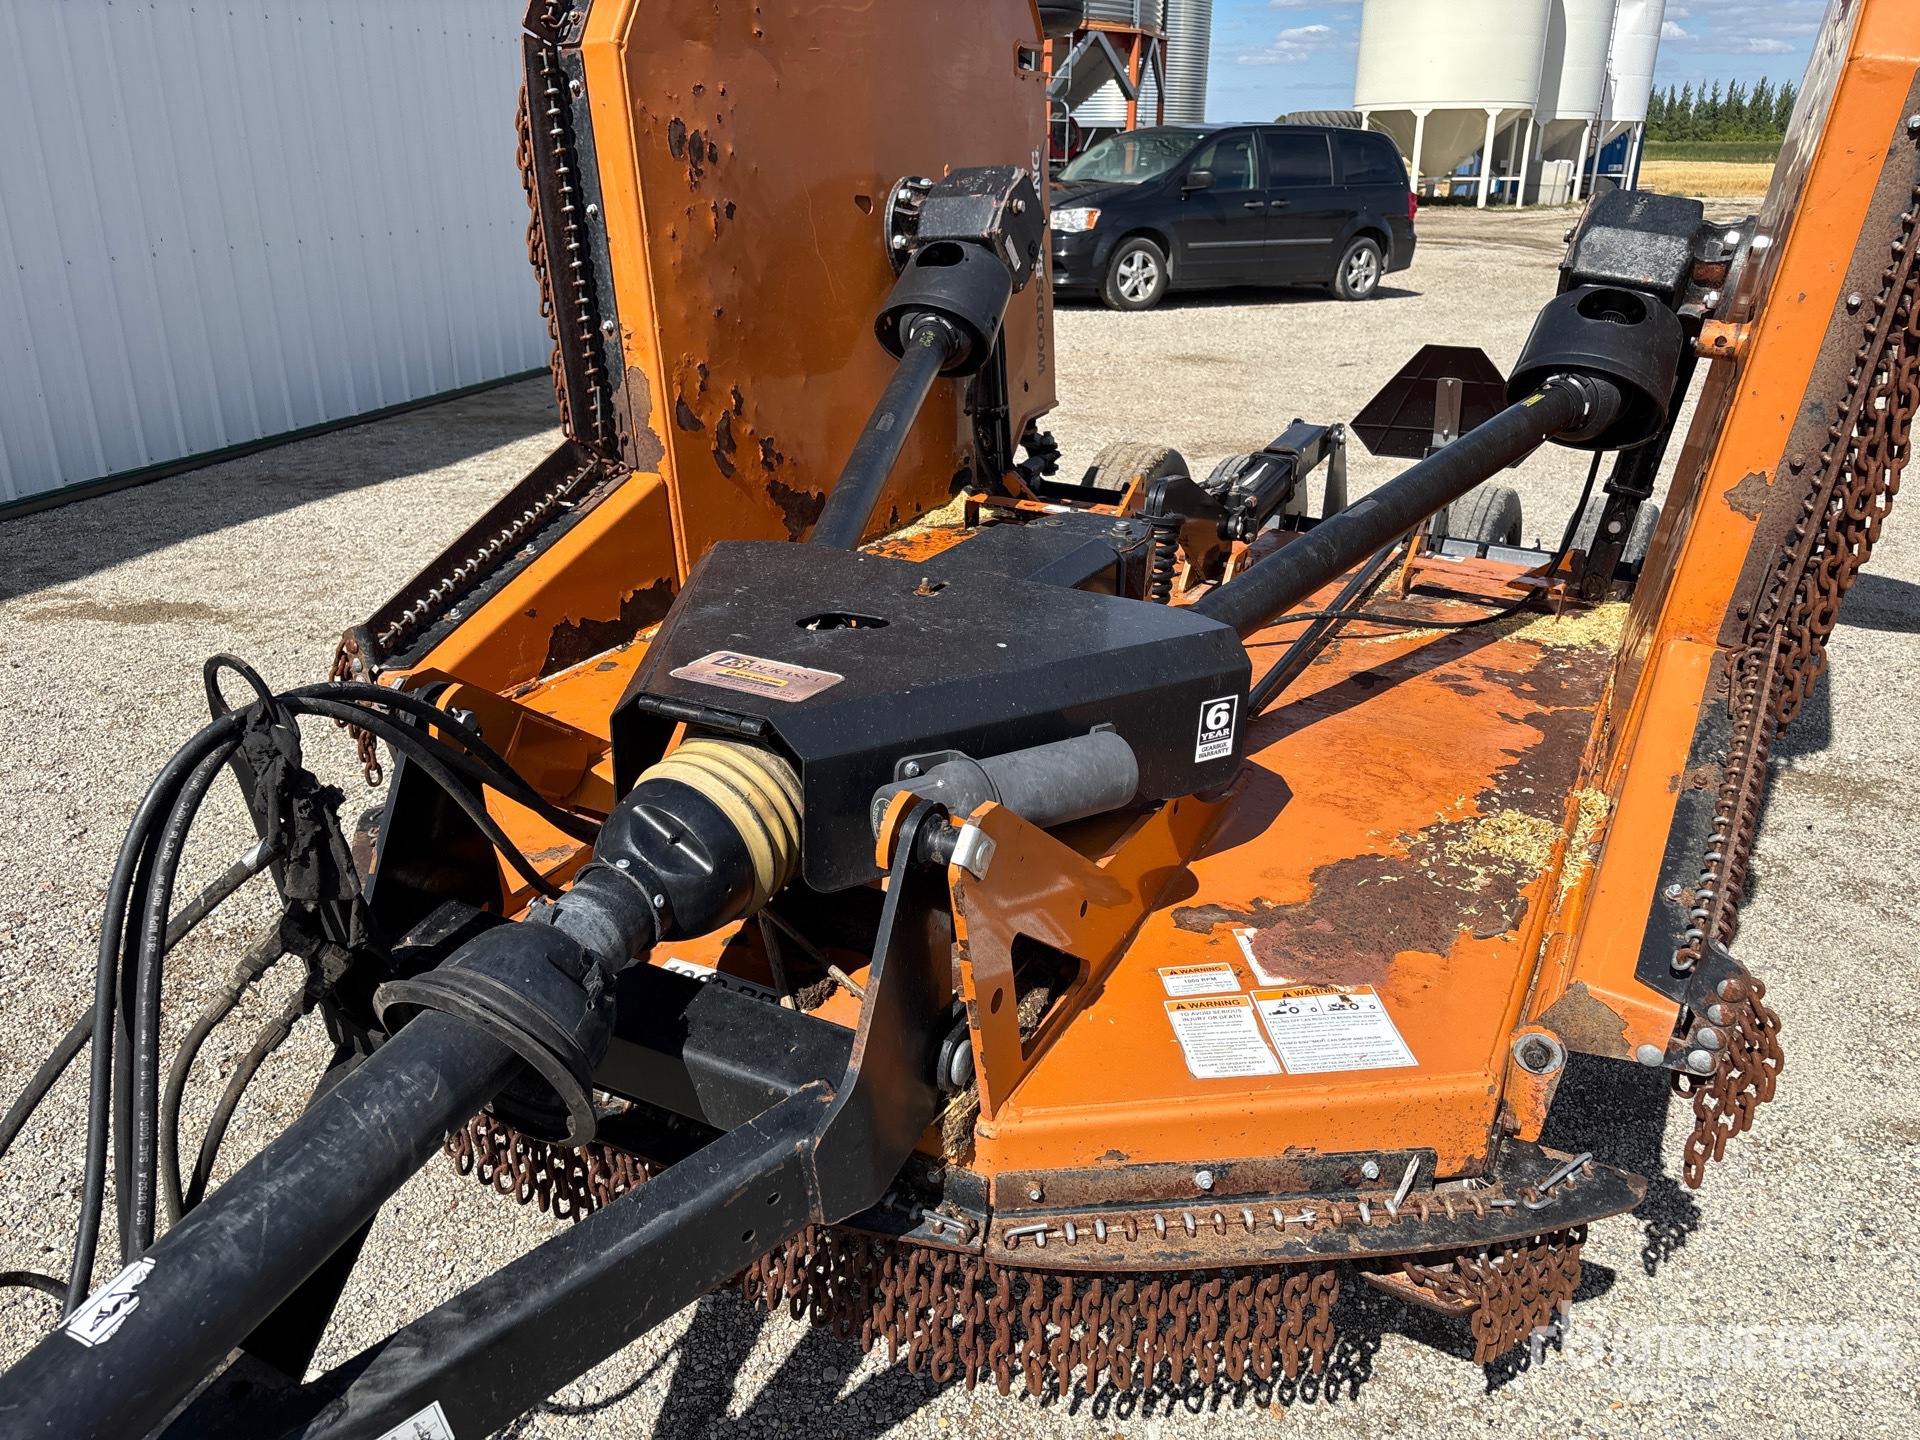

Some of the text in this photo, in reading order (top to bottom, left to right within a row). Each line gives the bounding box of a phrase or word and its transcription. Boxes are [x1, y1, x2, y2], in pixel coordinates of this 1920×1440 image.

[1205, 702, 1231, 730] 6
[1201, 728, 1230, 741] YEAR
[1198, 747, 1229, 759] WARRANTY
[1201, 742, 1228, 753] GEARBOX
[152, 888, 165, 908] 4060
[148, 915, 160, 935] MPa
[146, 936, 157, 953] 28.0
[1293, 986, 1344, 997] WARNIN
[1188, 999, 1240, 1008] WARNING
[138, 1145, 150, 1163] SAE
[137, 1172, 149, 1206] 18752-A
[136, 1209, 147, 1226] ISO
